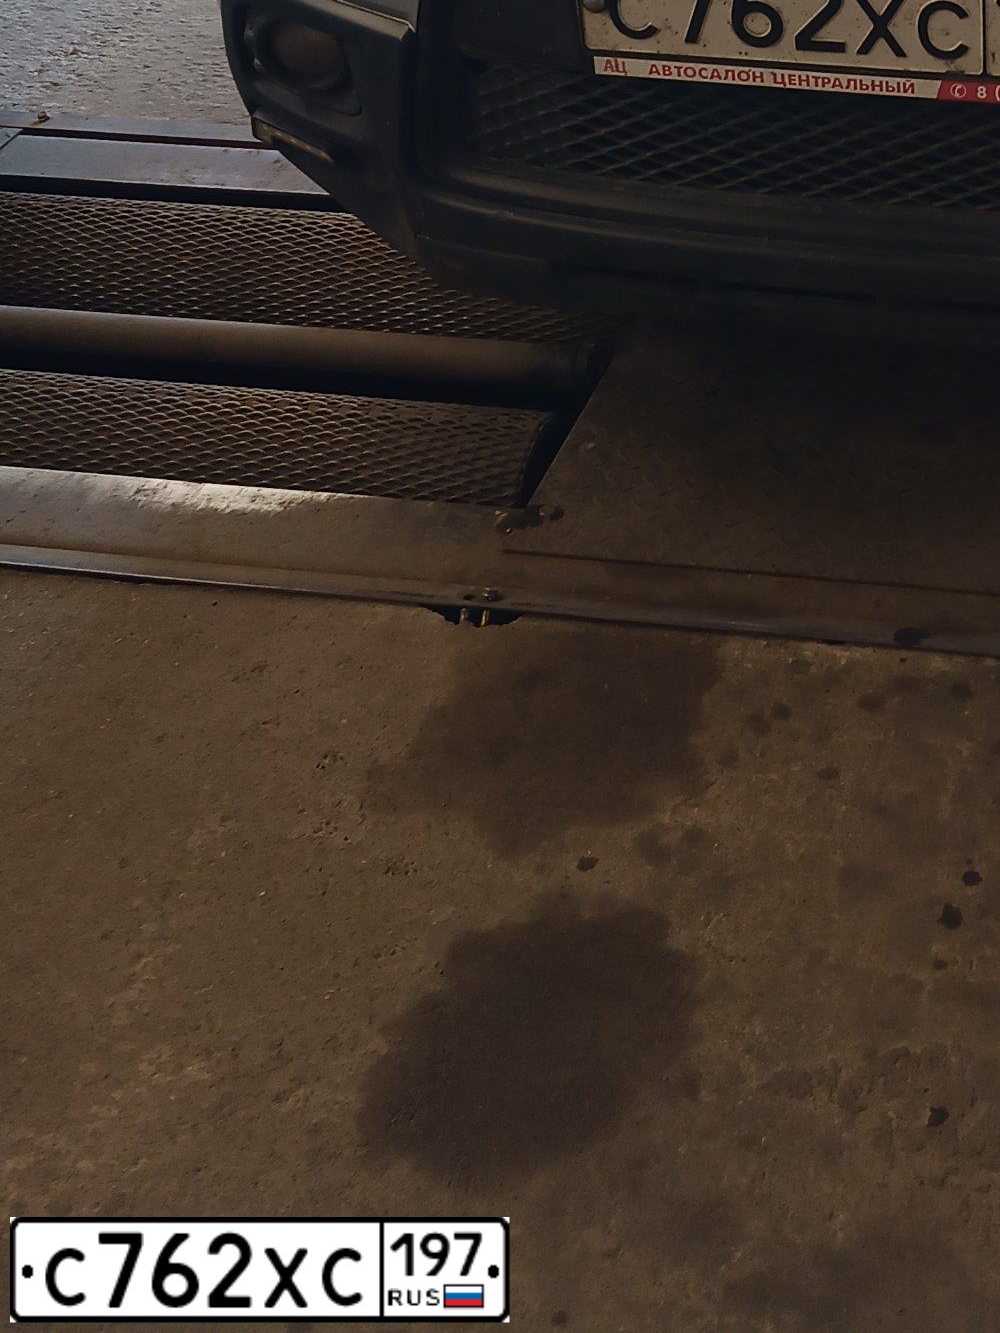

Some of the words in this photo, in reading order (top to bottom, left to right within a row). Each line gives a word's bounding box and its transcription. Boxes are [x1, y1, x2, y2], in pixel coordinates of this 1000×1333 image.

[603, 58, 628, 76] АЦ
[648, 63, 766, 84] АВТОСАЛОН
[771, 70, 916, 95] ЦЕНТРАЛЬНЫЙ
[976, 85, 988, 99] 8
